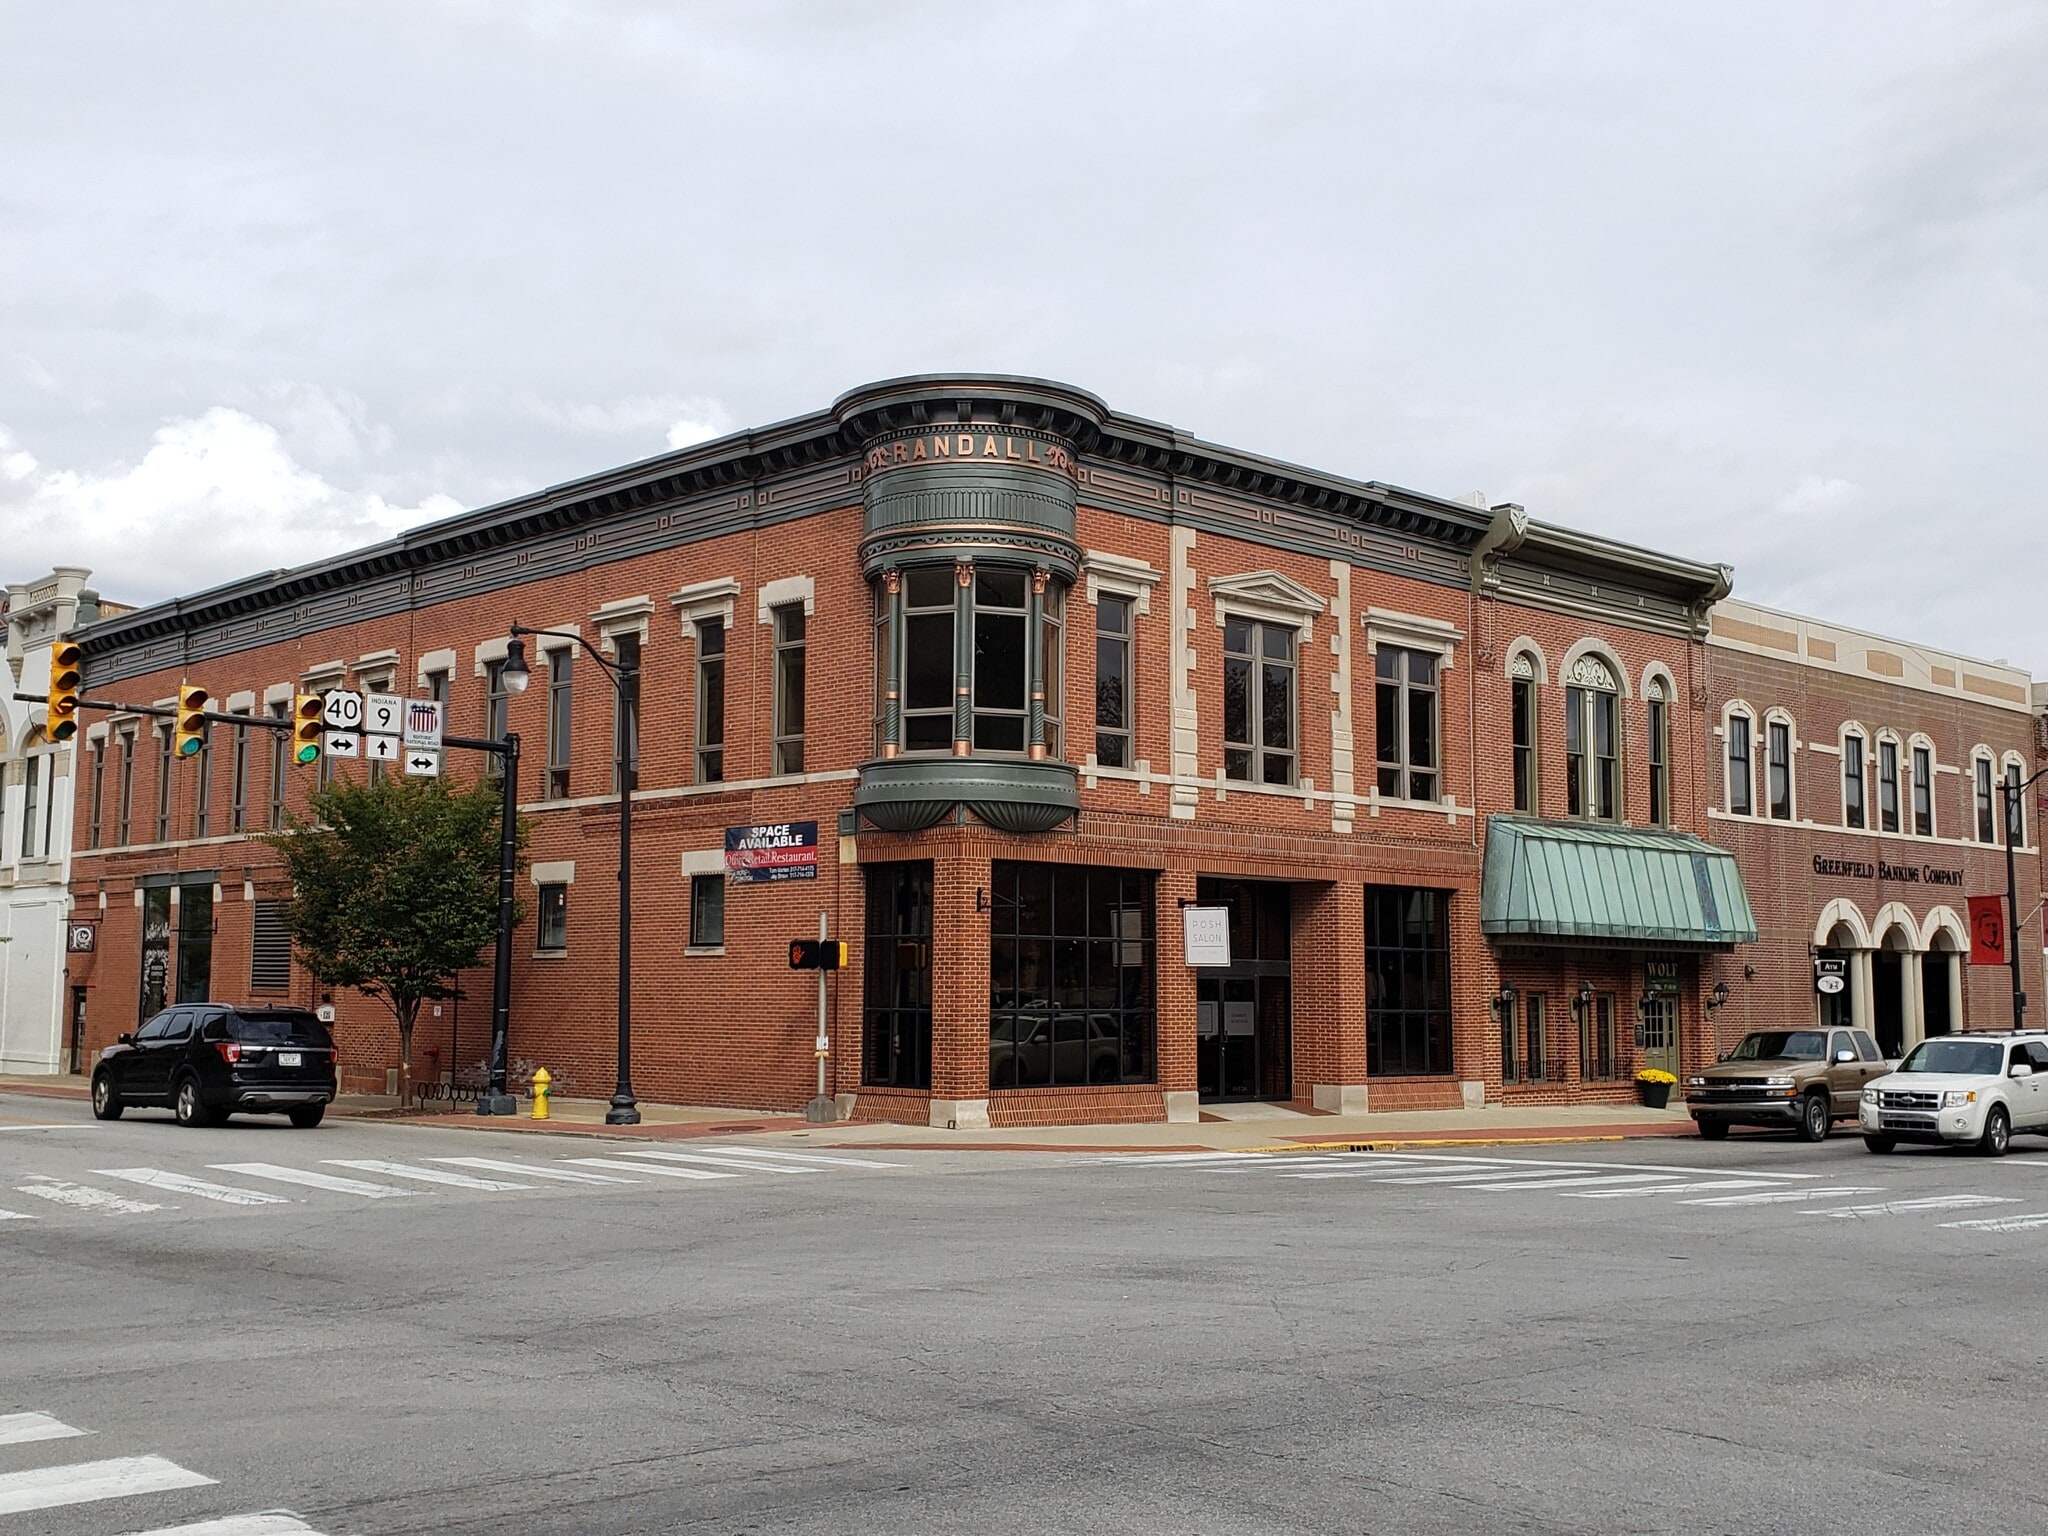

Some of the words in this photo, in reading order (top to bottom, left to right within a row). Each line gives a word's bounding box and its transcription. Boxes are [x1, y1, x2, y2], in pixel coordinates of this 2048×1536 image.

[893, 434, 1041, 463] RANDALL
[327, 698, 358, 720] 40
[371, 697, 398, 706] INDIANA
[377, 707, 391, 728] 9
[752, 824, 790, 838] SPACE
[738, 834, 803, 850] AVAILABLE
[1192, 920, 1222, 929] POSH
[1192, 933, 1222, 943] SALON
[1647, 962, 1678, 977] WOLF
